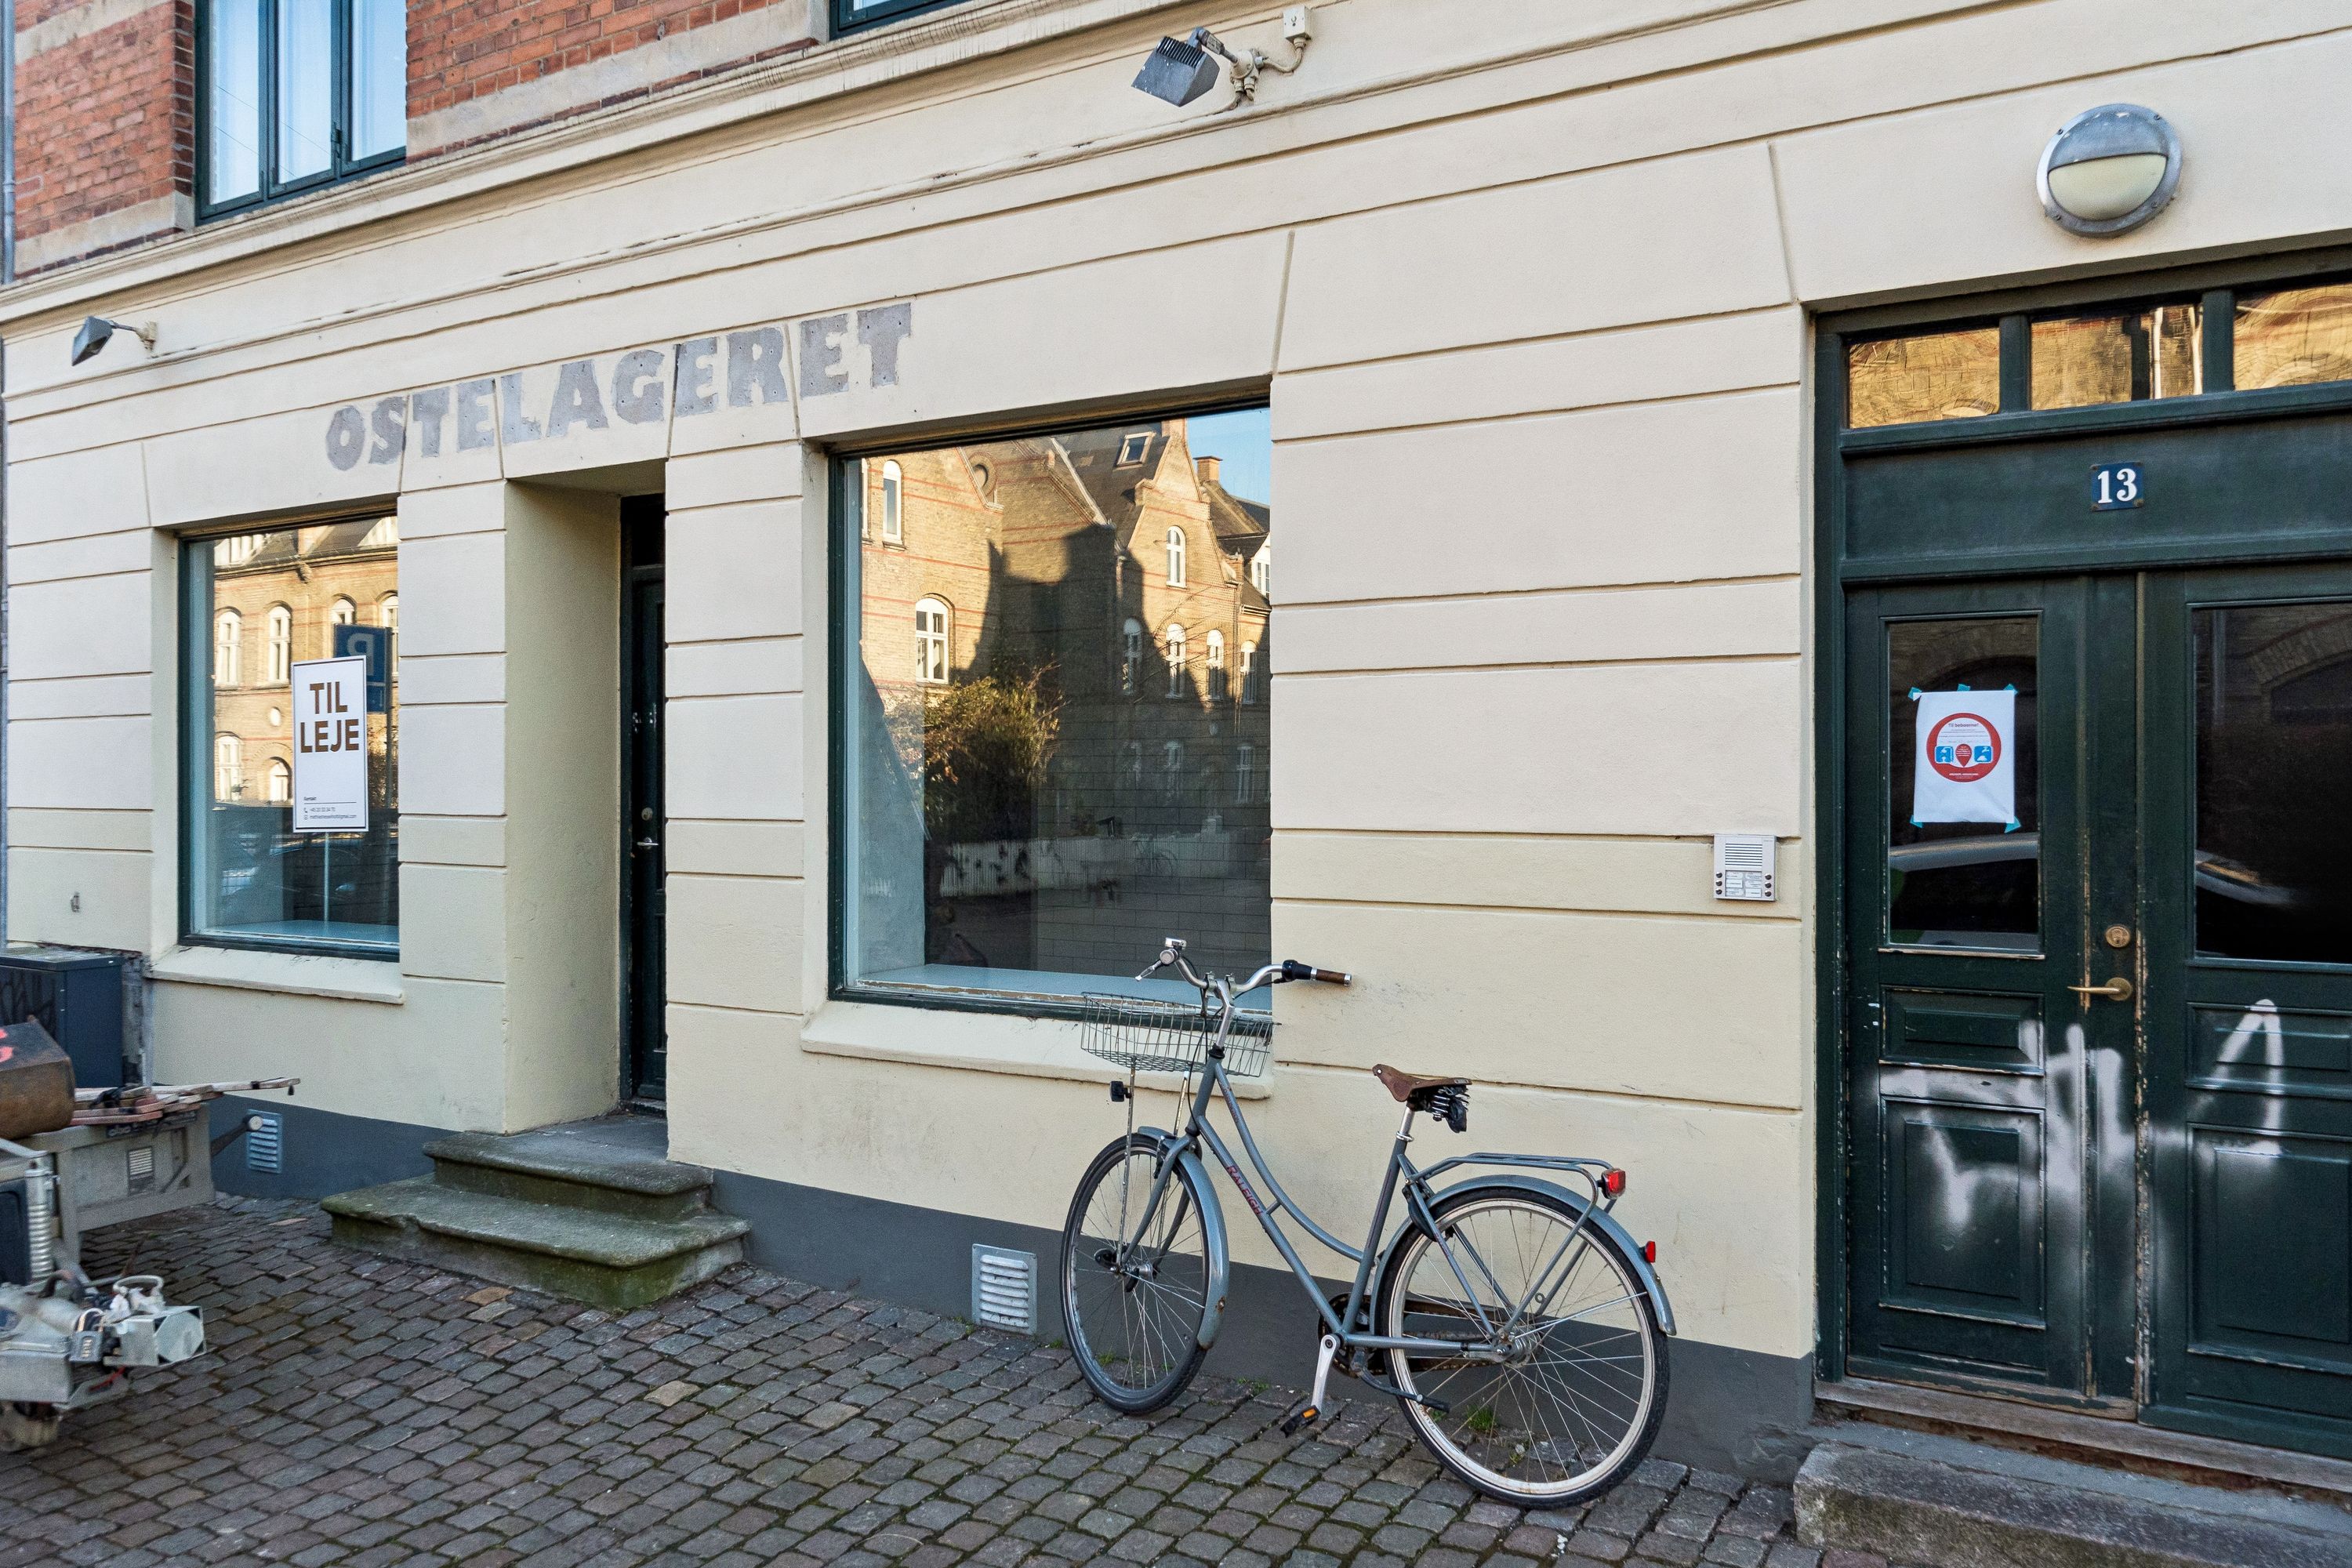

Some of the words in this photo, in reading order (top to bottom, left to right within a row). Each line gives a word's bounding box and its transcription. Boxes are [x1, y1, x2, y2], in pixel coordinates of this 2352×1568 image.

[325, 303, 912, 470] OSTELAGERET
[2097, 468, 2137, 504] 13
[310, 681, 347, 714] TIL
[300, 718, 359, 753] LEJE
[1225, 1165, 1264, 1215] RALEIGH
